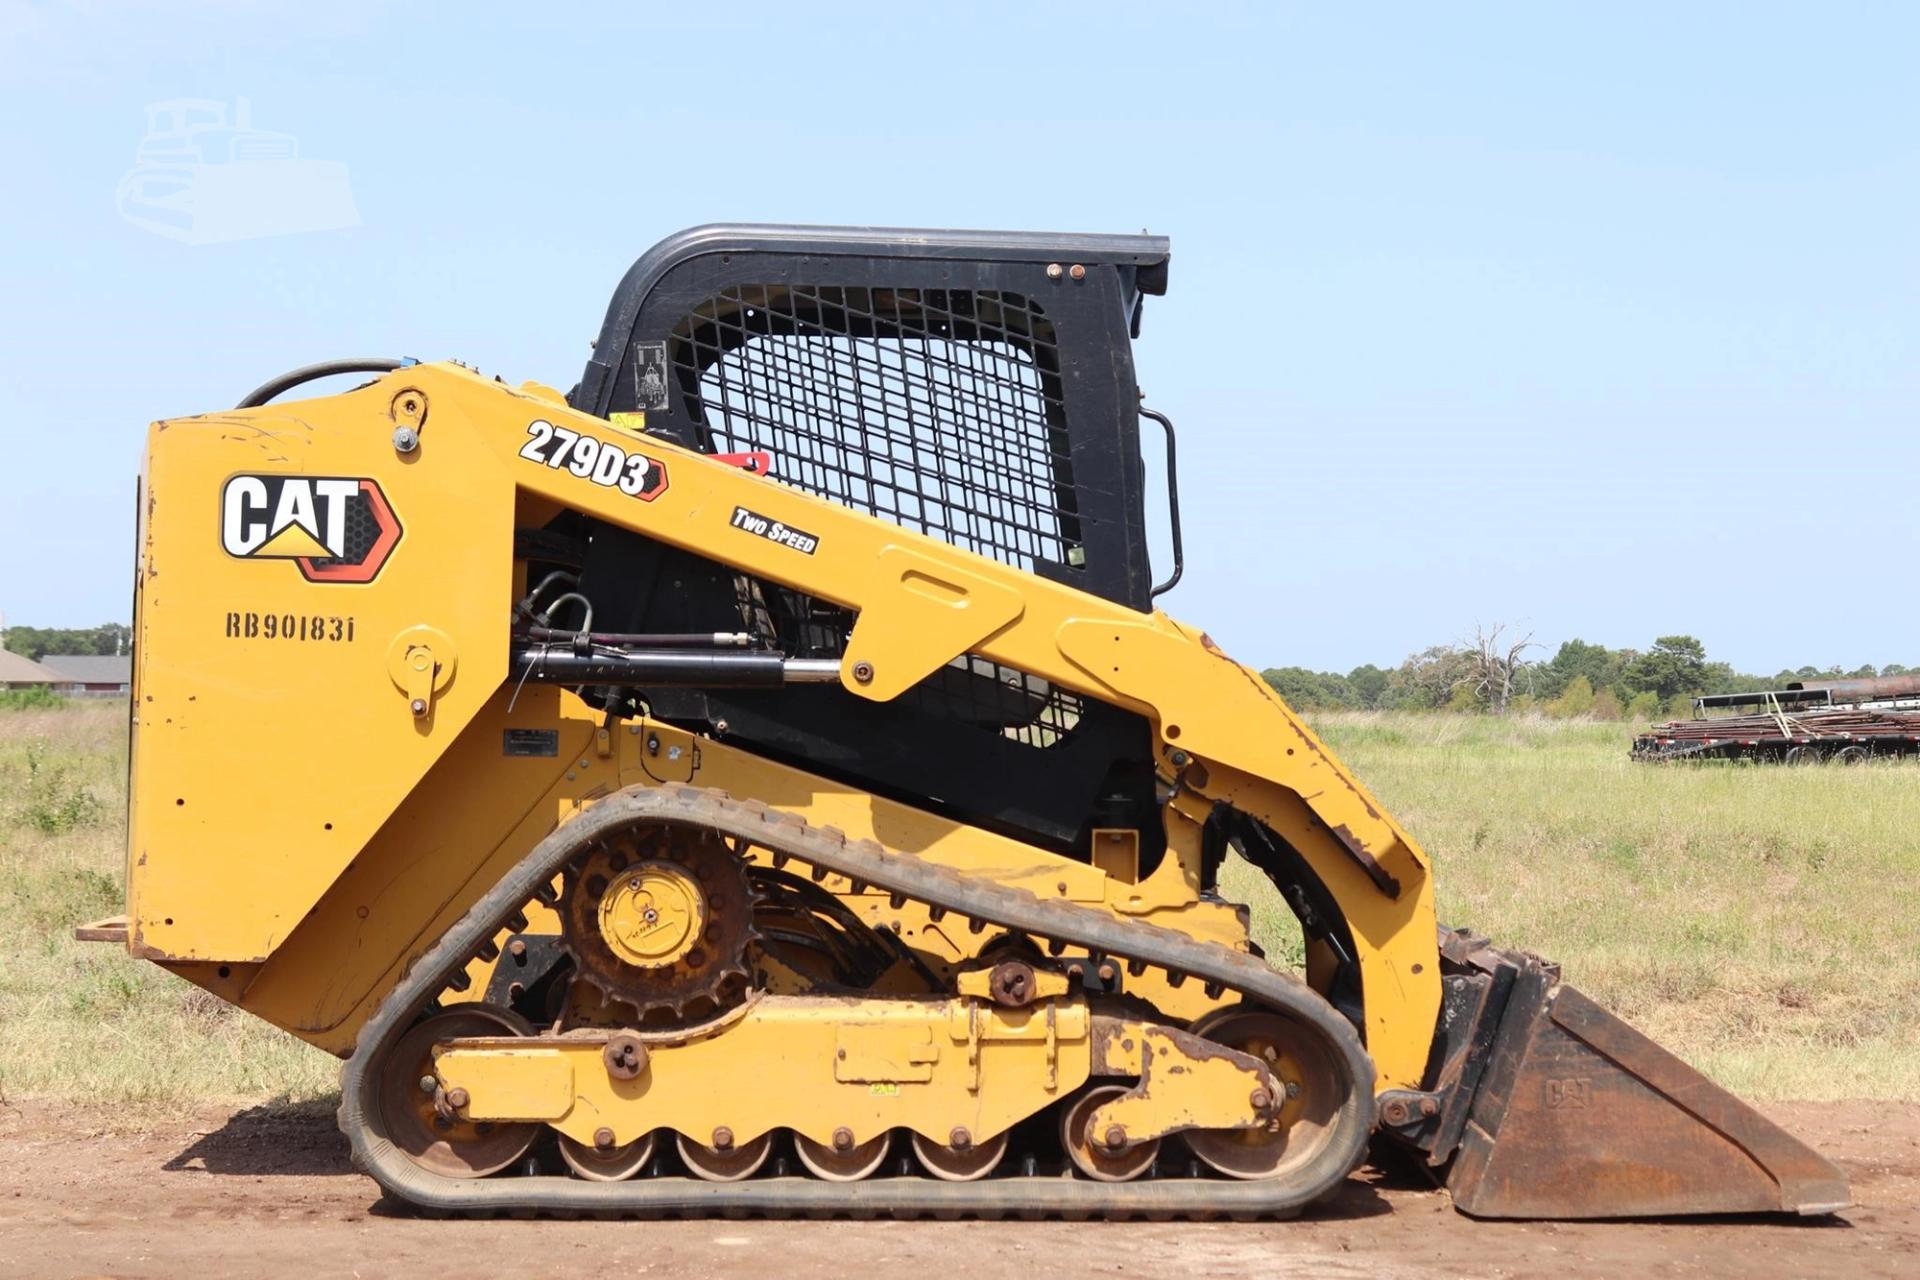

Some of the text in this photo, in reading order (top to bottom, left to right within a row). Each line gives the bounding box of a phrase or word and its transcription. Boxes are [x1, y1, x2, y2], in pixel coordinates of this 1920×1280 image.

[520, 420, 650, 496] 279D3
[223, 476, 359, 558] CAT
[1545, 1078, 1592, 1109] CAT
